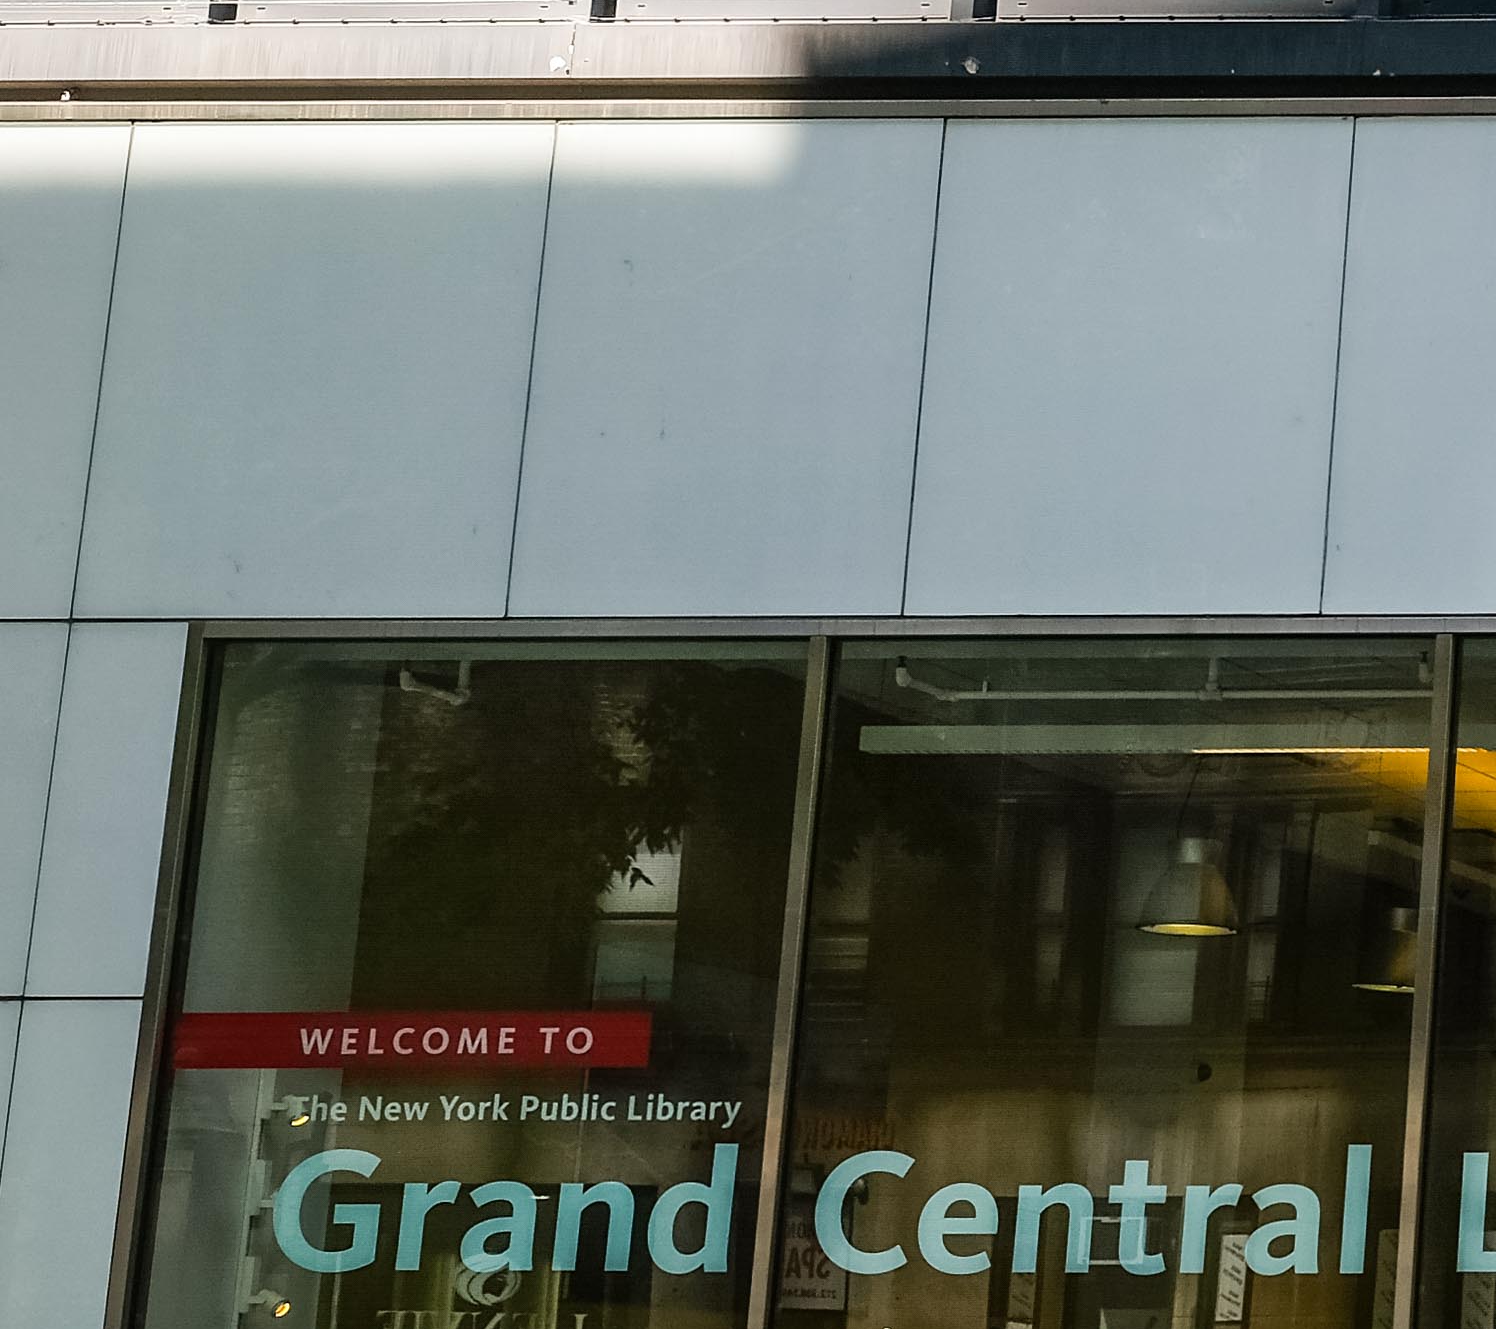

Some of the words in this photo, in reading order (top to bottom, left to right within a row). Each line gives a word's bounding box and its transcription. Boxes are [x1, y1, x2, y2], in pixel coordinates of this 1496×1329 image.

[300, 1027, 517, 1055] WELCOME
[539, 1026, 594, 1055] TO
[289, 1094, 347, 1121] The
[359, 1095, 430, 1121] New
[439, 1093, 509, 1121] York
[519, 1093, 617, 1121] Public
[627, 1093, 742, 1129] Library
[273, 1142, 739, 1274] Grand
[814, 1143, 1373, 1276] Central
